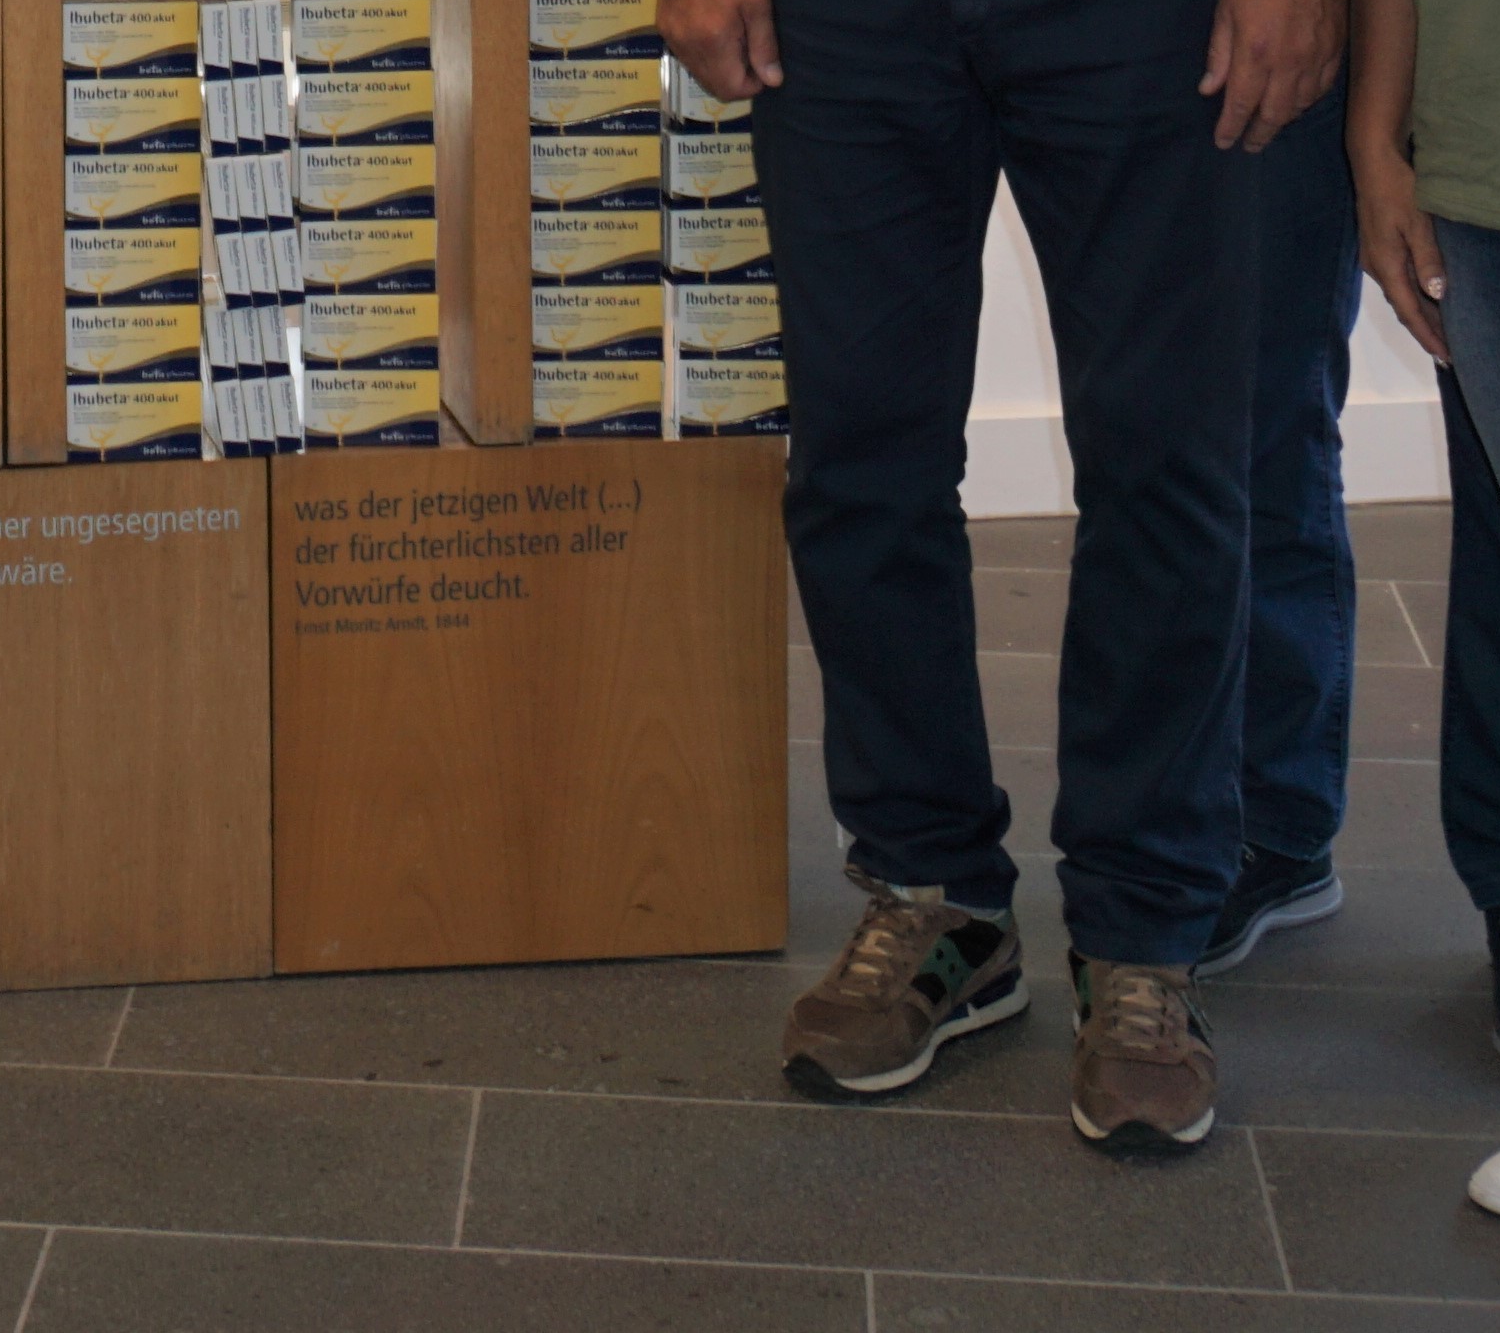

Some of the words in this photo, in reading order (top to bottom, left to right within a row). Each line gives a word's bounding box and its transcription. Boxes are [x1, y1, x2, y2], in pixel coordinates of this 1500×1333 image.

[130, 13, 151, 23] 400
[362, 8, 383, 19] 400
[593, 147, 613, 157] 400
[368, 230, 389, 240] 400
[131, 239, 152, 249] 400
[295, 499, 349, 522] was
[359, 491, 402, 520] der
[411, 487, 518, 524] jetzigen
[526, 483, 588, 514] Welt
[42, 506, 241, 545] ungesegneten
[295, 537, 338, 566] der
[350, 529, 560, 564] fürchterlichsten
[570, 525, 628, 553] aller
[295, 575, 420, 608] Vorwürfe
[430, 572, 530, 603] deucht.
